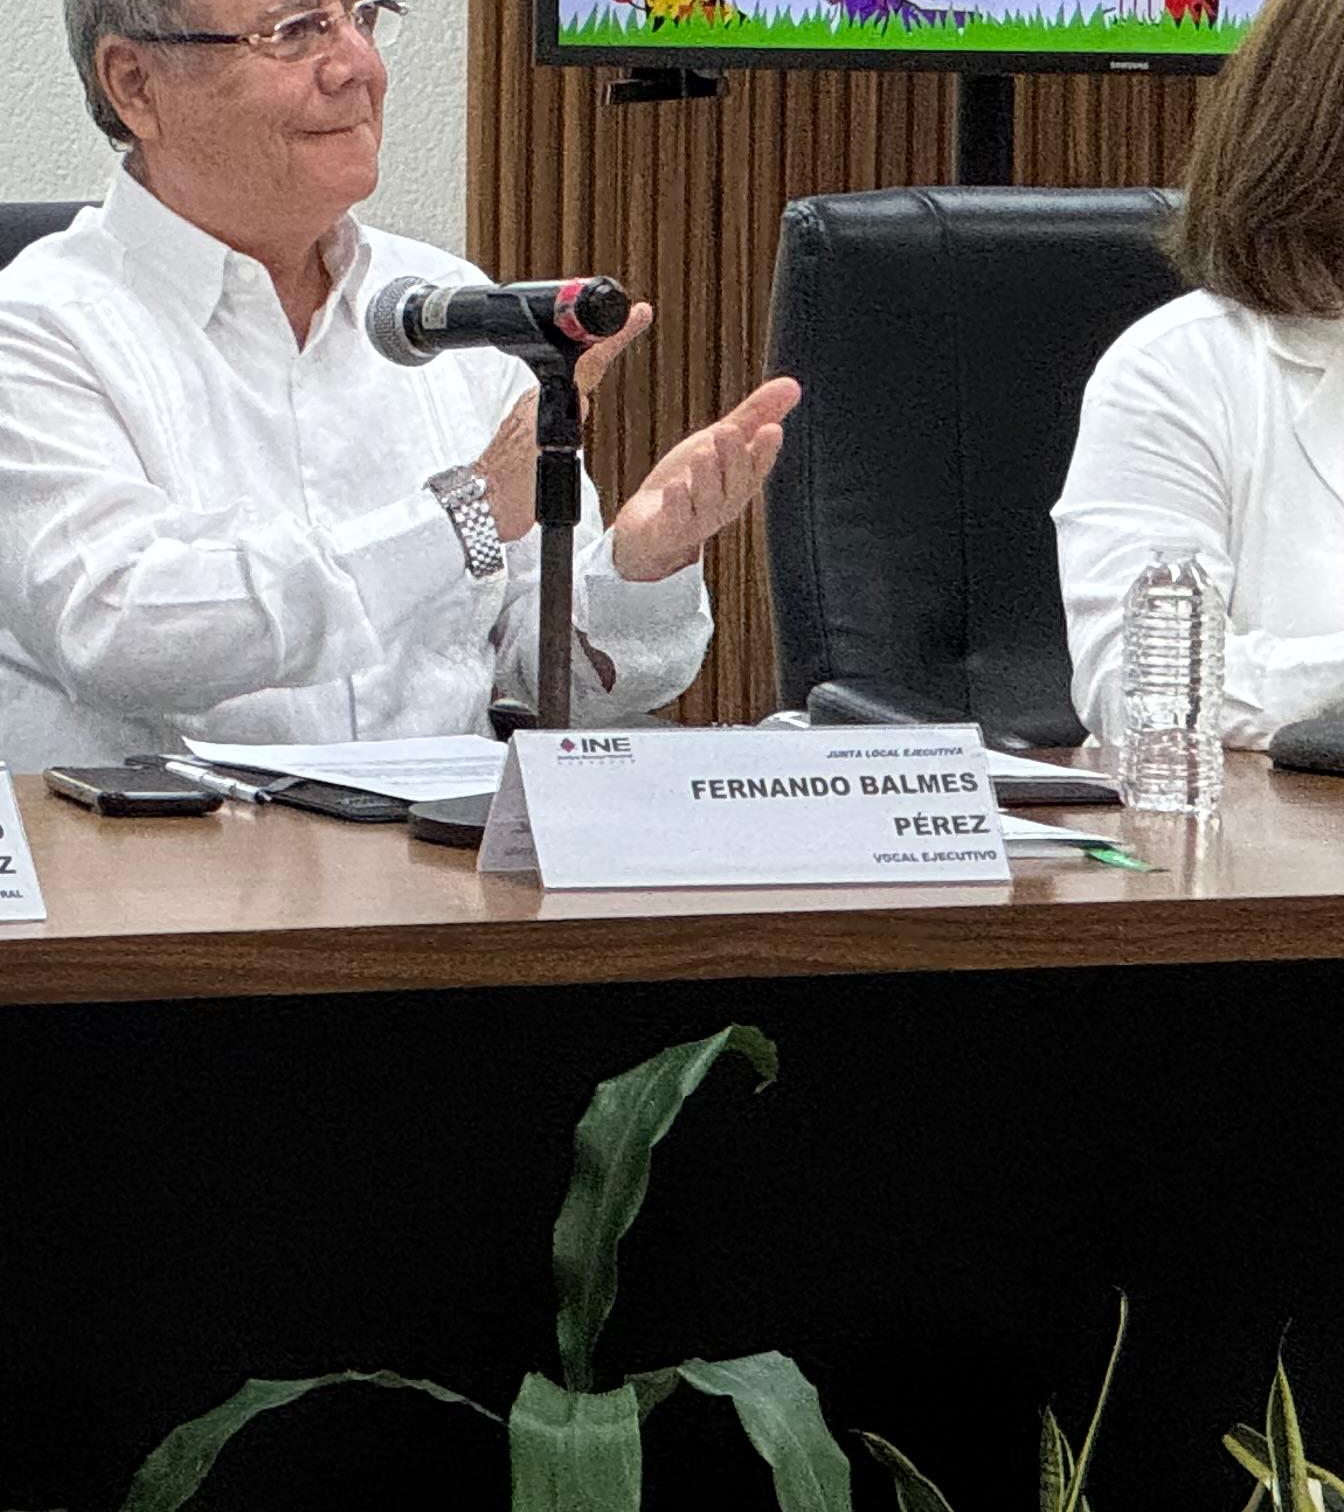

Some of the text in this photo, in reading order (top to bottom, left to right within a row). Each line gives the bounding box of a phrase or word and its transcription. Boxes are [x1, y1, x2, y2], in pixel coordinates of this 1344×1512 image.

[581, 738, 632, 753] INE
[827, 746, 964, 759] JUNTA LOCAL EJECUTIVA
[691, 772, 979, 800] FERNANDO BALMES
[894, 811, 991, 837] PÉREZ
[873, 850, 998, 864] VOCAL EJECUTIVO
